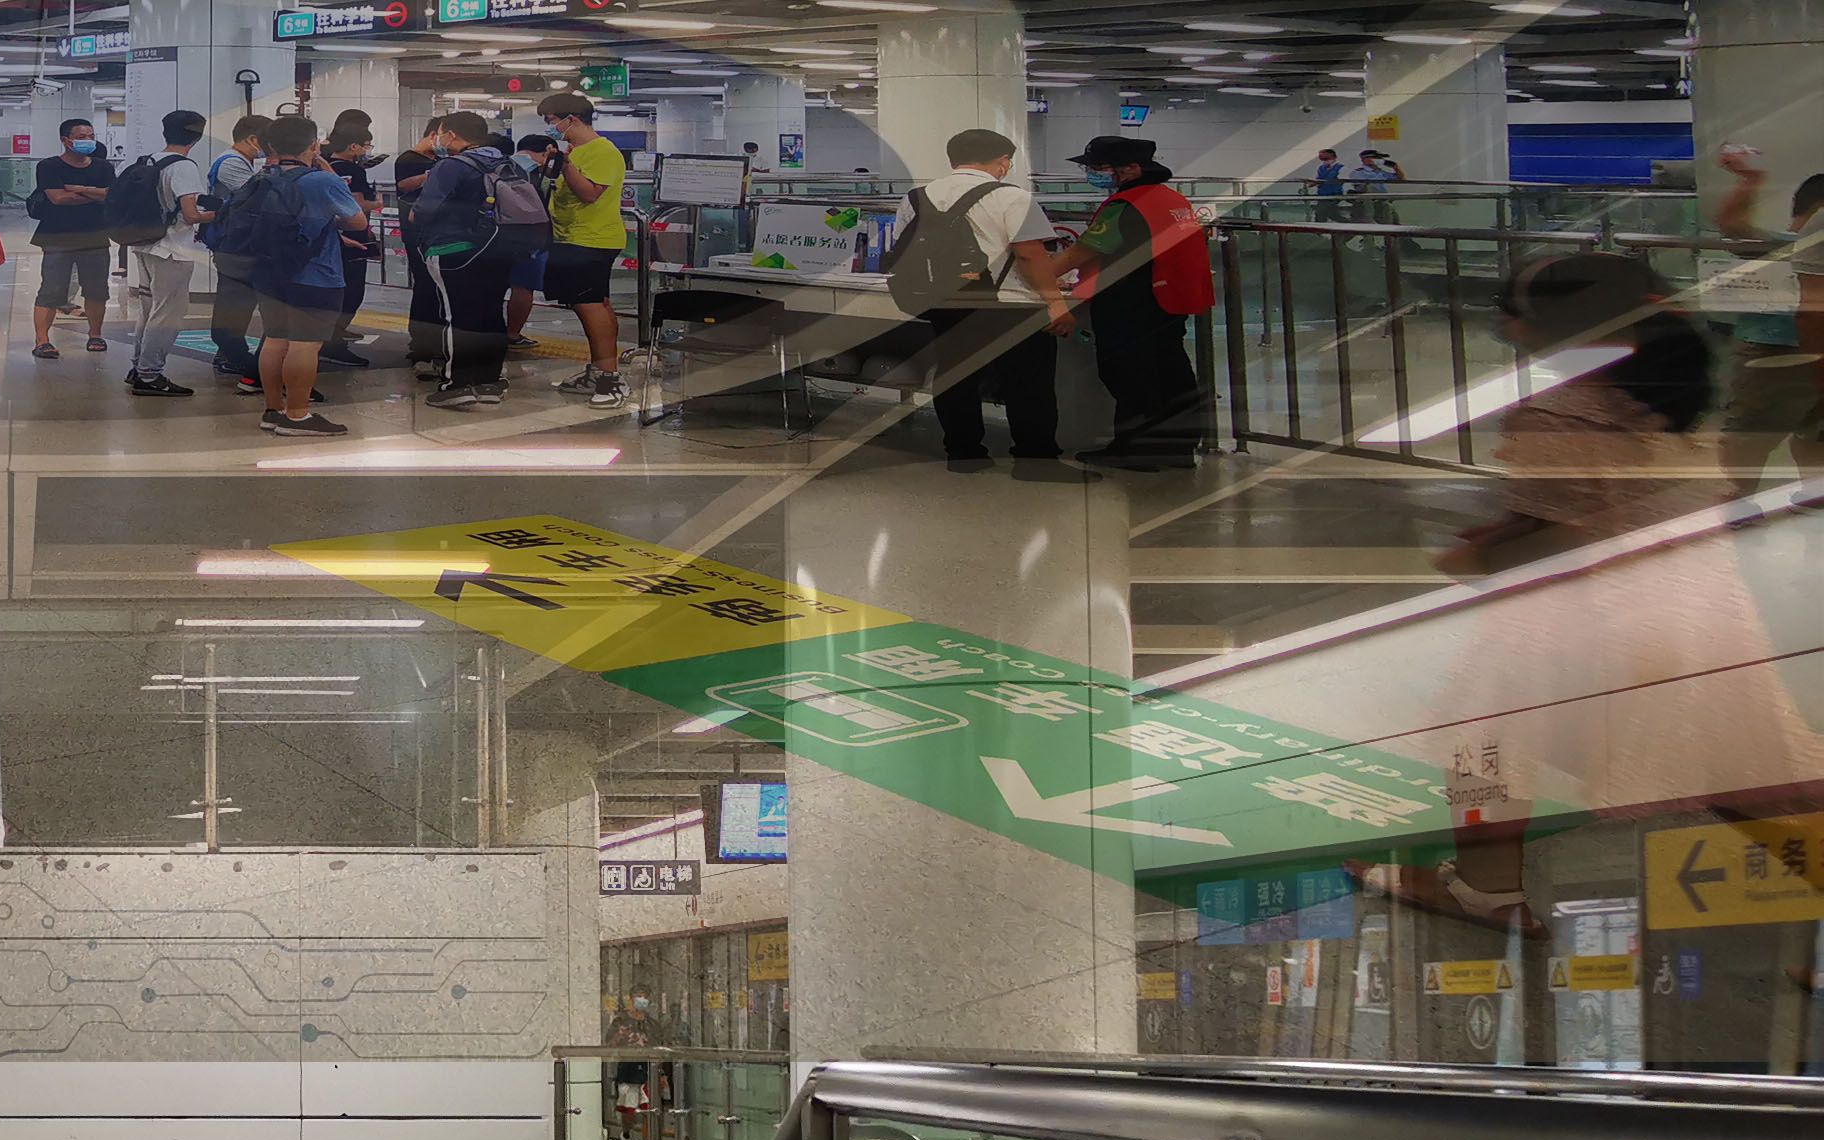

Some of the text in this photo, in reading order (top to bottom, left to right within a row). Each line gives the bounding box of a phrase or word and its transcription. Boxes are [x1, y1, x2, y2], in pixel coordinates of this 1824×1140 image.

[447, 0, 459, 18] 6
[284, 17, 293, 32] 6
[762, 233, 848, 250] 志愿者服务站
[466, 527, 806, 627] 商务车厢
[843, 644, 1434, 827] 普通车厢
[1446, 784, 1508, 806] Songgang
[1744, 837, 1824, 881] 商务
[660, 865, 692, 882] 电梯
